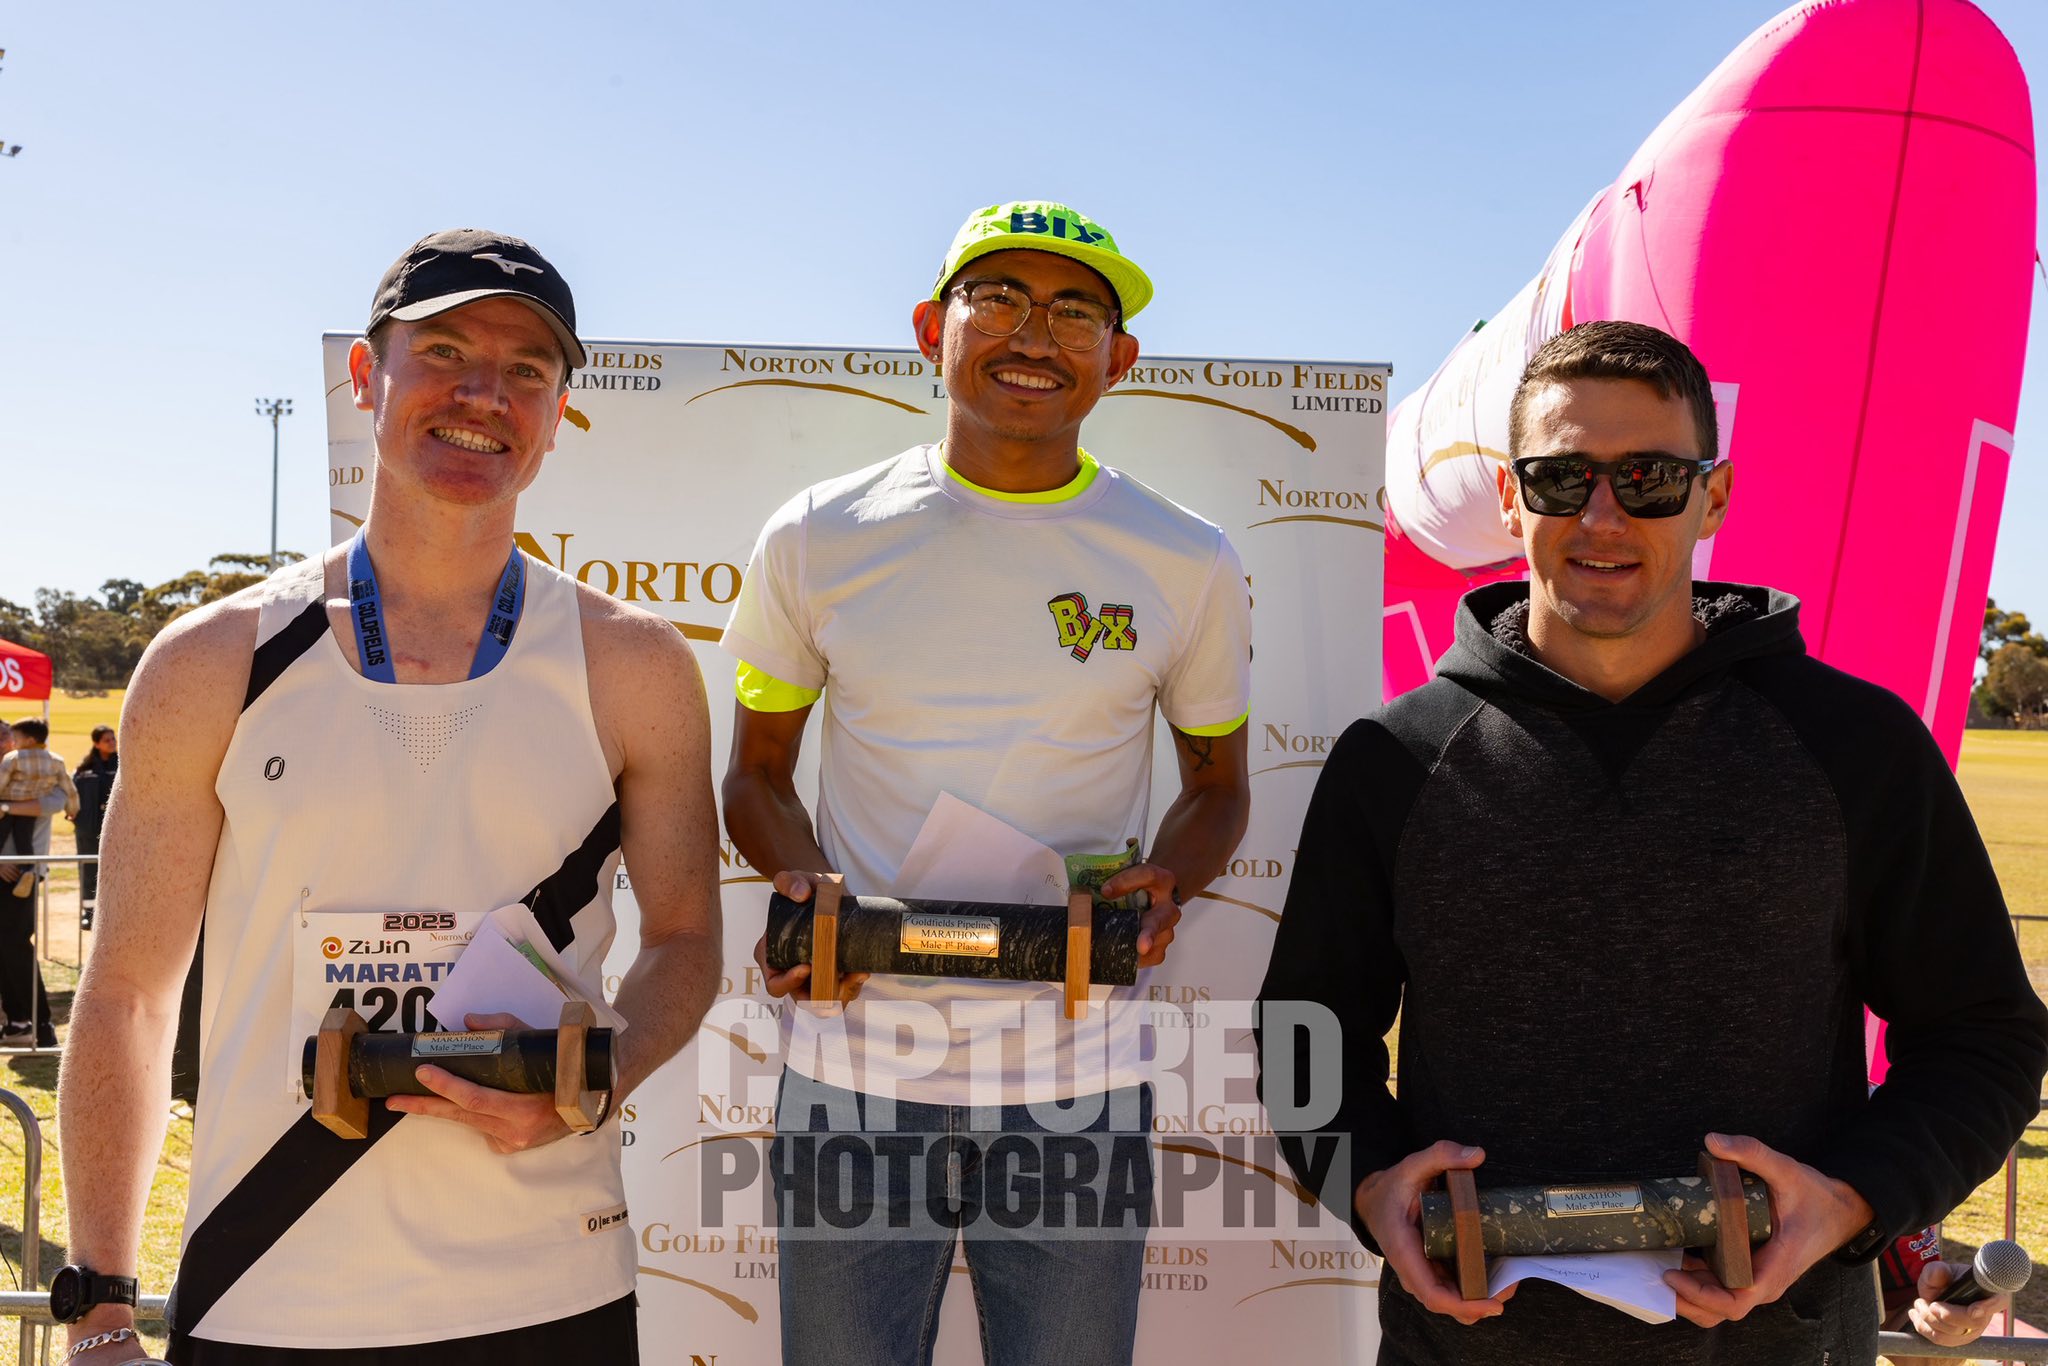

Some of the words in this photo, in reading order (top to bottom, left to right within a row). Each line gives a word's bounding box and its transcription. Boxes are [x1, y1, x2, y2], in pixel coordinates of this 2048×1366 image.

[588, 345, 663, 370] IELDS
[568, 373, 662, 391] LIMITED
[1119, 367, 1195, 385] RTON
[1292, 395, 1382, 414] LIMITED
[329, 466, 364, 487] OLD
[514, 532, 749, 604] NORTO
[358, 601, 385, 666] GOLDFIELDS
[1047, 591, 1138, 664] BIX
[1262, 723, 1339, 753] NORT
[383, 912, 456, 931] 2025
[911, 917, 955, 927] Goldfields
[957, 919, 992, 931] Pipeline
[921, 929, 980, 940] MARATHON
[920, 940, 942, 949] Male
[957, 942, 980, 951] Place
[326, 962, 455, 983] MARAT
[1149, 985, 1211, 1004] ELDS
[430, 1044, 450, 1052] Male
[697, 1094, 775, 1125] NORT
[1564, 1191, 1622, 1201] MARATHON
[1566, 1203, 1587, 1211] Male
[1602, 1200, 1624, 1209] Place
[1145, 1246, 1208, 1266] ELDS
